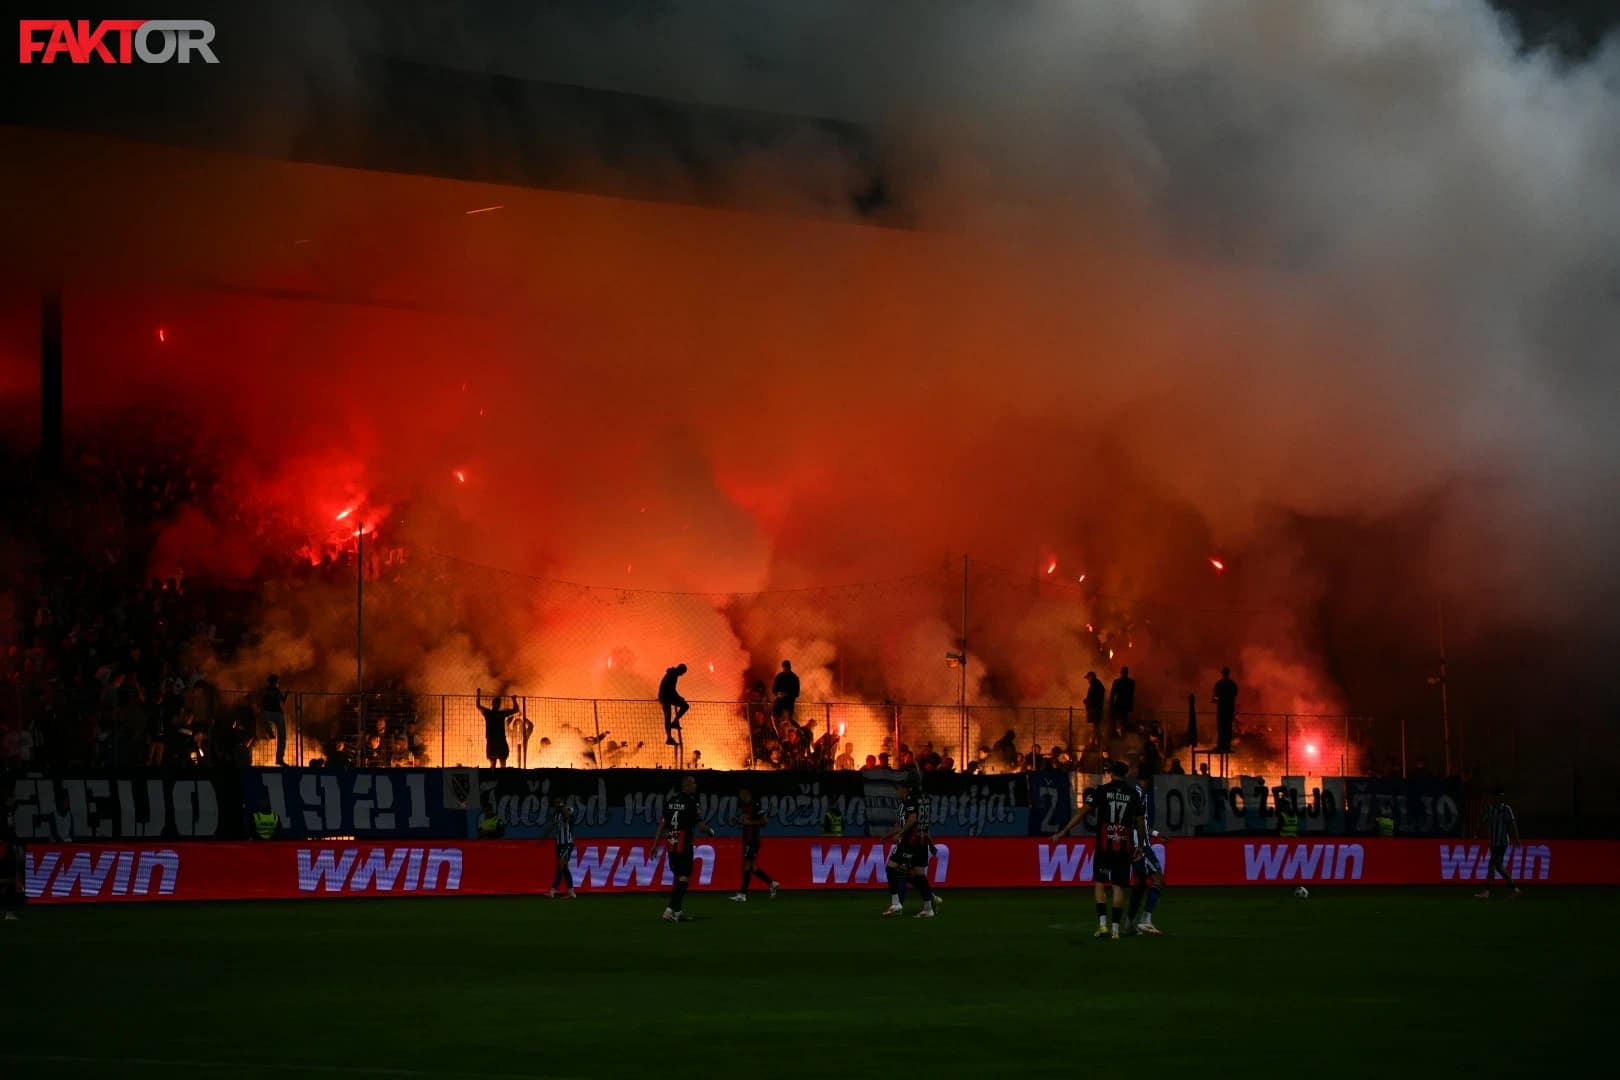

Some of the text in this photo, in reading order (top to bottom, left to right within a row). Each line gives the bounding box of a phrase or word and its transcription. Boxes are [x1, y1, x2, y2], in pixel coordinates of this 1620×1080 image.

[262, 771, 431, 831] 1921
[1108, 800, 1128, 824] 17
[670, 810, 679, 829] 4
